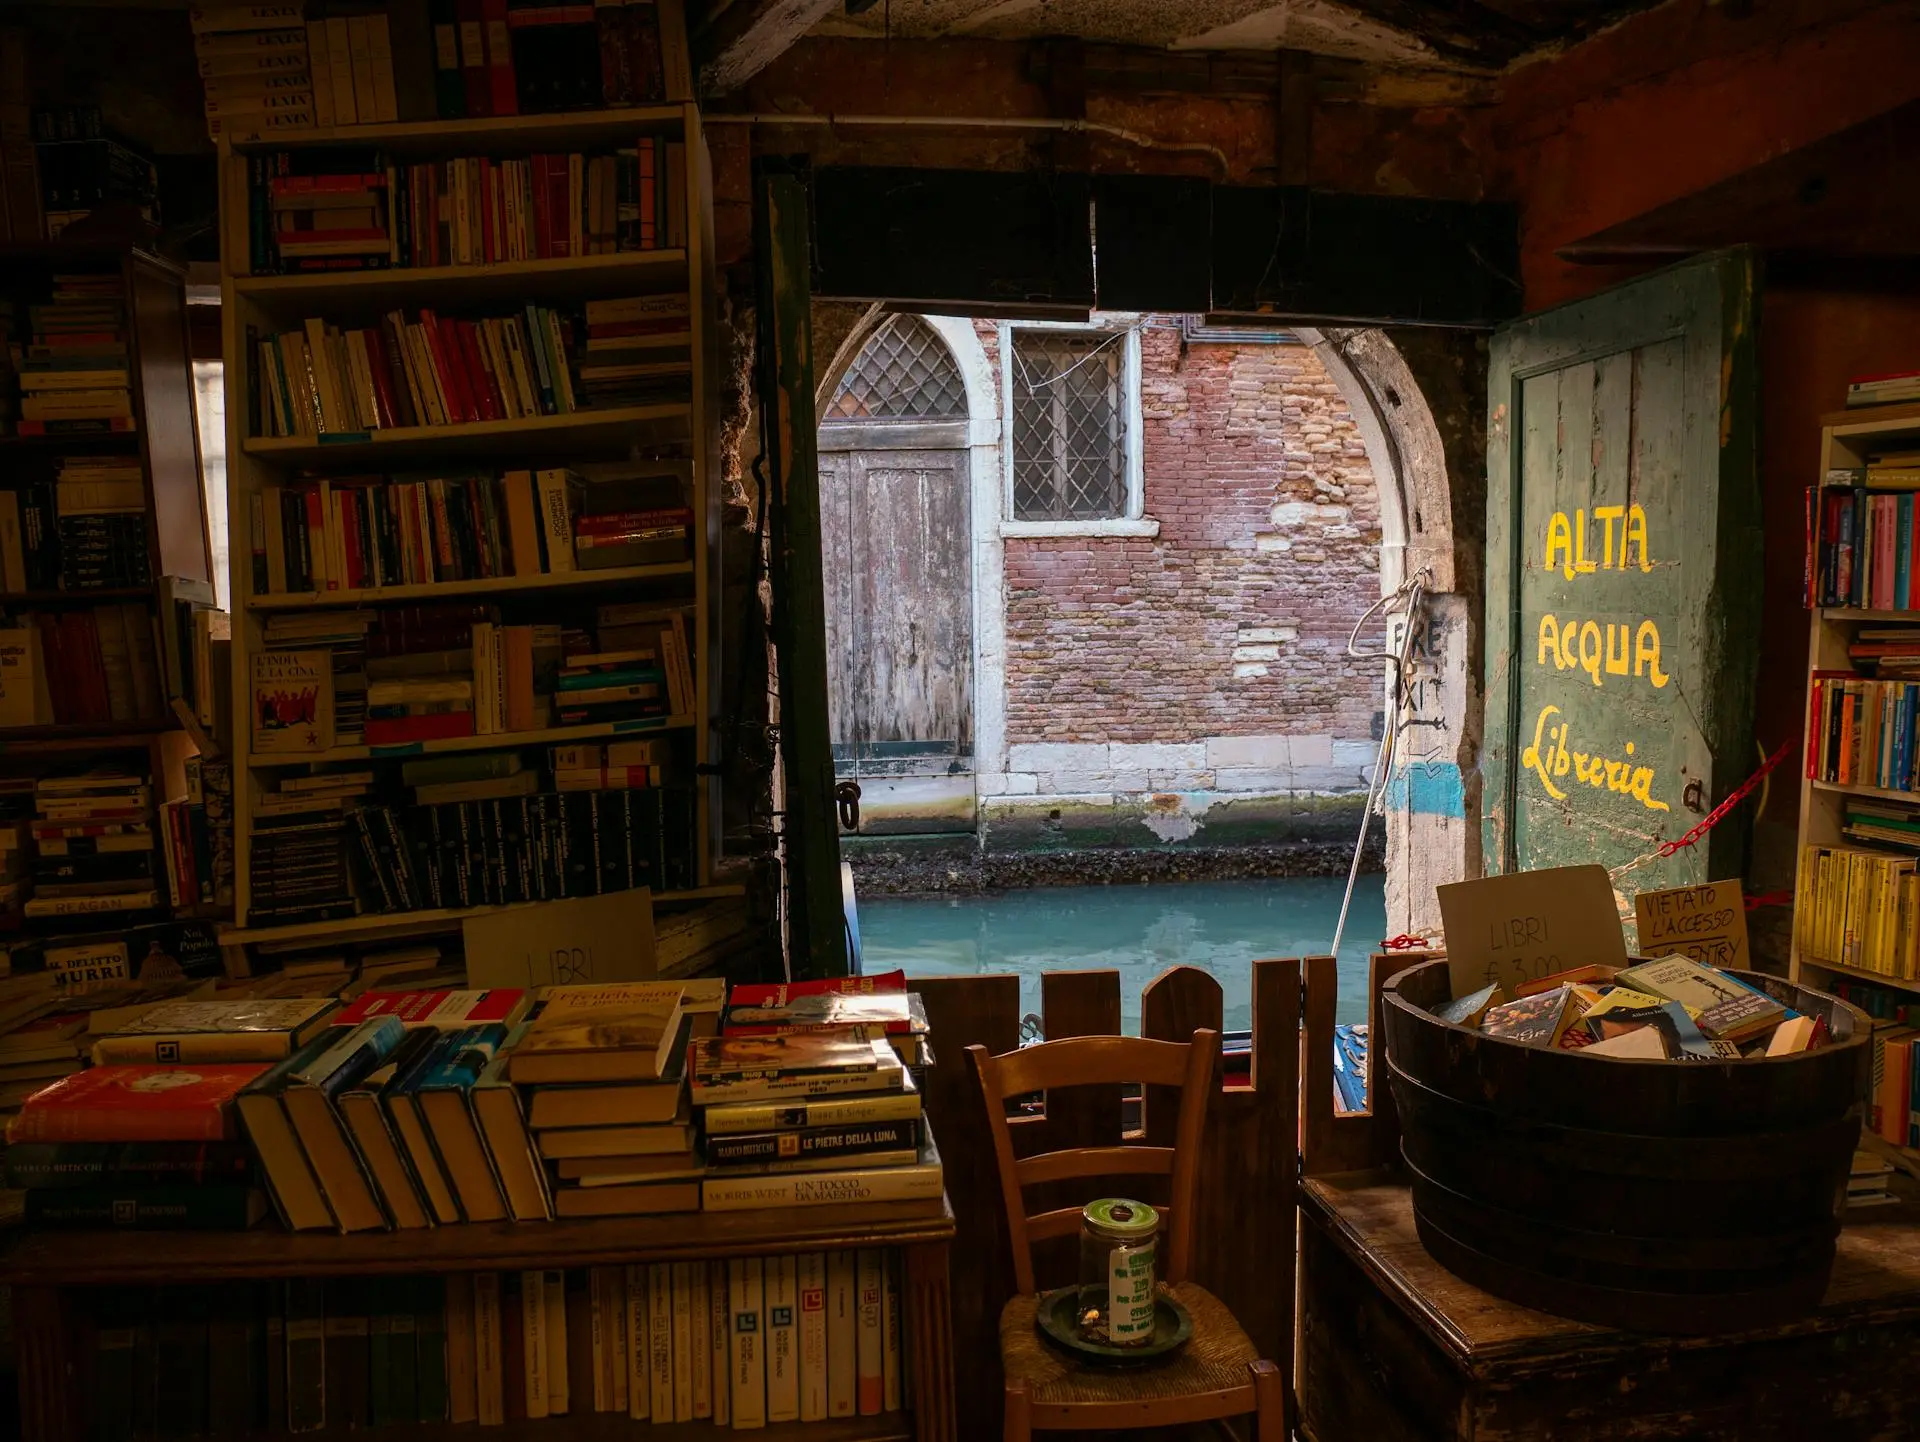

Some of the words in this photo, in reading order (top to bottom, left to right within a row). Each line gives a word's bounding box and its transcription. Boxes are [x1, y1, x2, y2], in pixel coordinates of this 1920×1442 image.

[1543, 502, 1656, 582] ALTA
[1394, 620, 1443, 658] FRE
[1537, 613, 1670, 689] ACQUA
[1522, 704, 1670, 812] Libreria
[55, 898, 123, 914] REAGAN
[1645, 886, 1716, 918] VIETATO
[1489, 915, 1549, 951] LIBRI
[1651, 908, 1735, 938] L'ACCESSO
[66, 954, 122, 969] DELITTO
[527, 946, 595, 989] LIBRI
[1687, 937, 1742, 968] ENTRY
[54, 964, 125, 984] MURRI
[717, 1145, 744, 1158] MARCO
[802, 1137, 814, 1150] LE
[815, 1135, 845, 1149] PIETRE
[845, 1132, 872, 1146] DELLA
[874, 1129, 898, 1142] LUNA
[708, 1190, 753, 1202] MORRIS
[755, 1187, 788, 1199] WEST
[794, 1181, 814, 1192] UN
[818, 1178, 860, 1190] TOCCO
[794, 1191, 808, 1202] DA
[809, 1188, 872, 1201] MAESTRO
